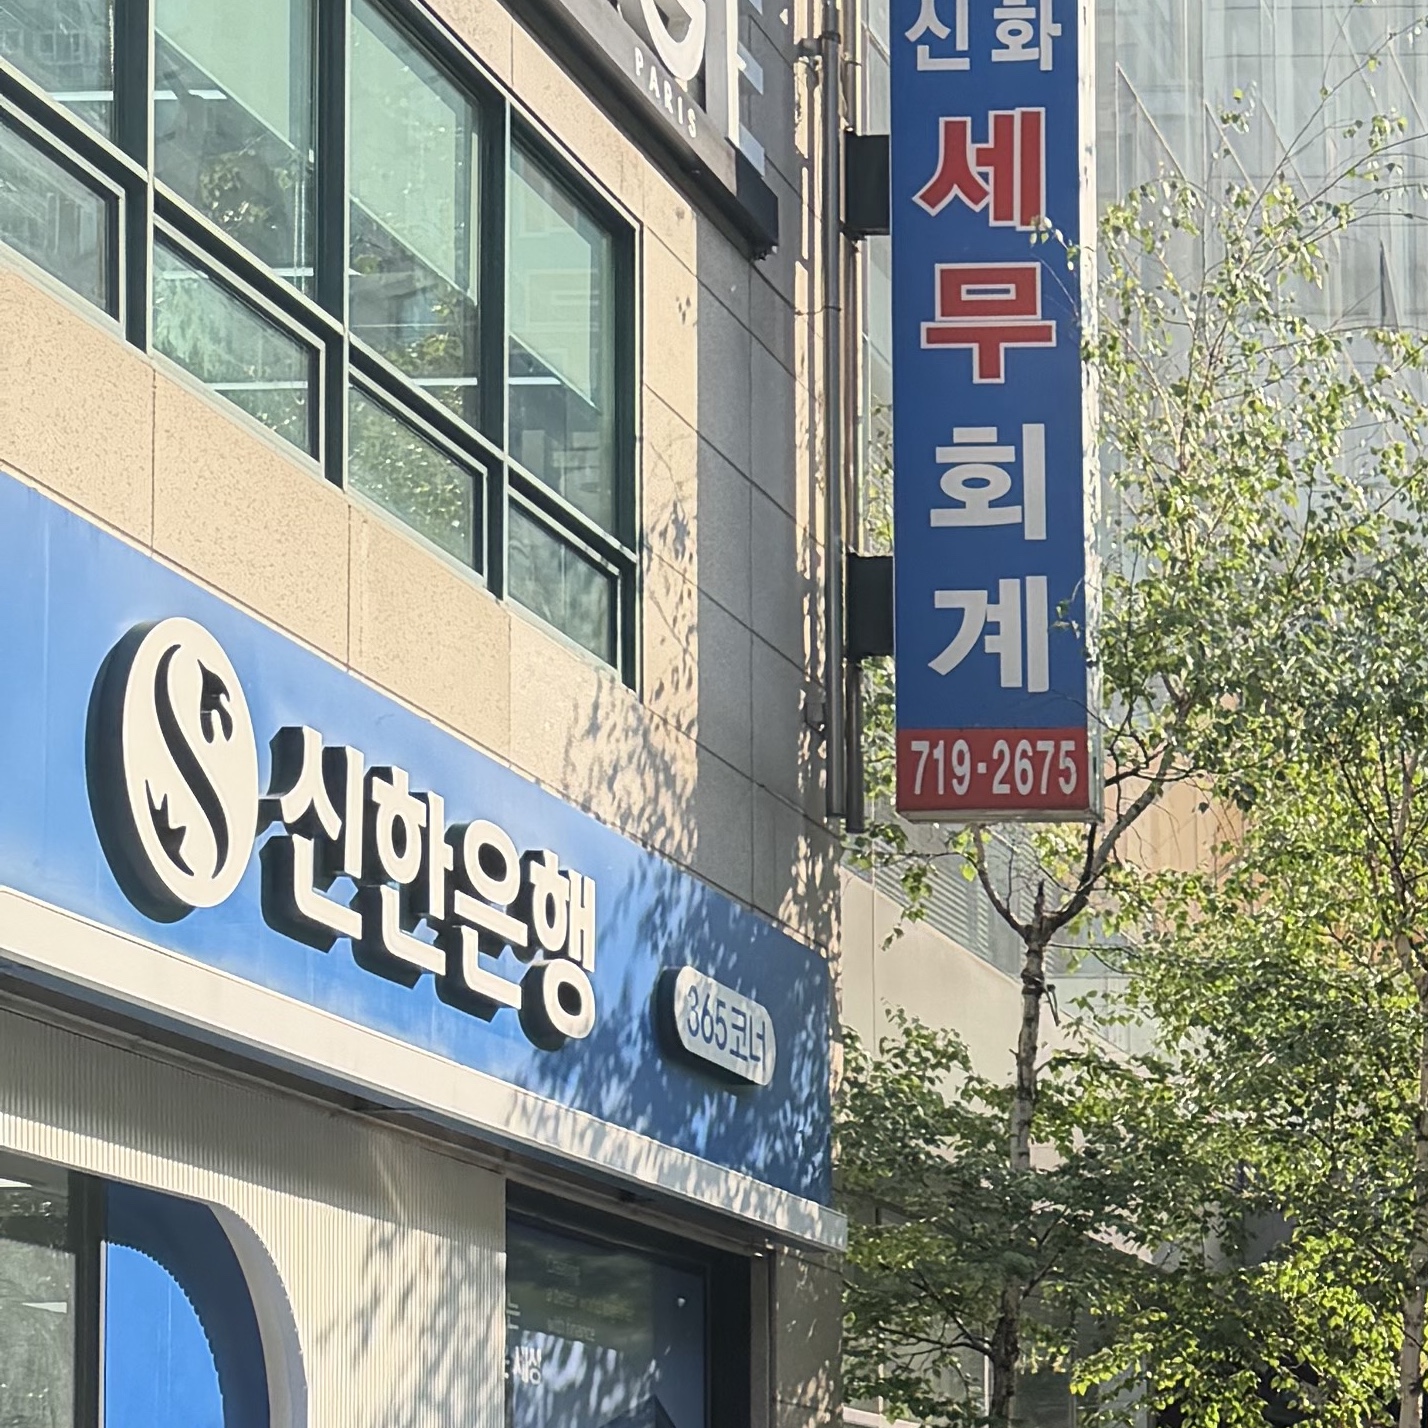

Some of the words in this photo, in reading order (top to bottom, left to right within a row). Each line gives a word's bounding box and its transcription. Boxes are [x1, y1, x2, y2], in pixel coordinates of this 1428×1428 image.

[904, 0, 1063, 70] 신화
[634, 47, 697, 138] PARIS
[911, 106, 1057, 695] 세무회계
[910, 739, 1078, 796] 719-2675
[274, 724, 597, 1040] 신한은행
[685, 984, 769, 1065] 365코너
